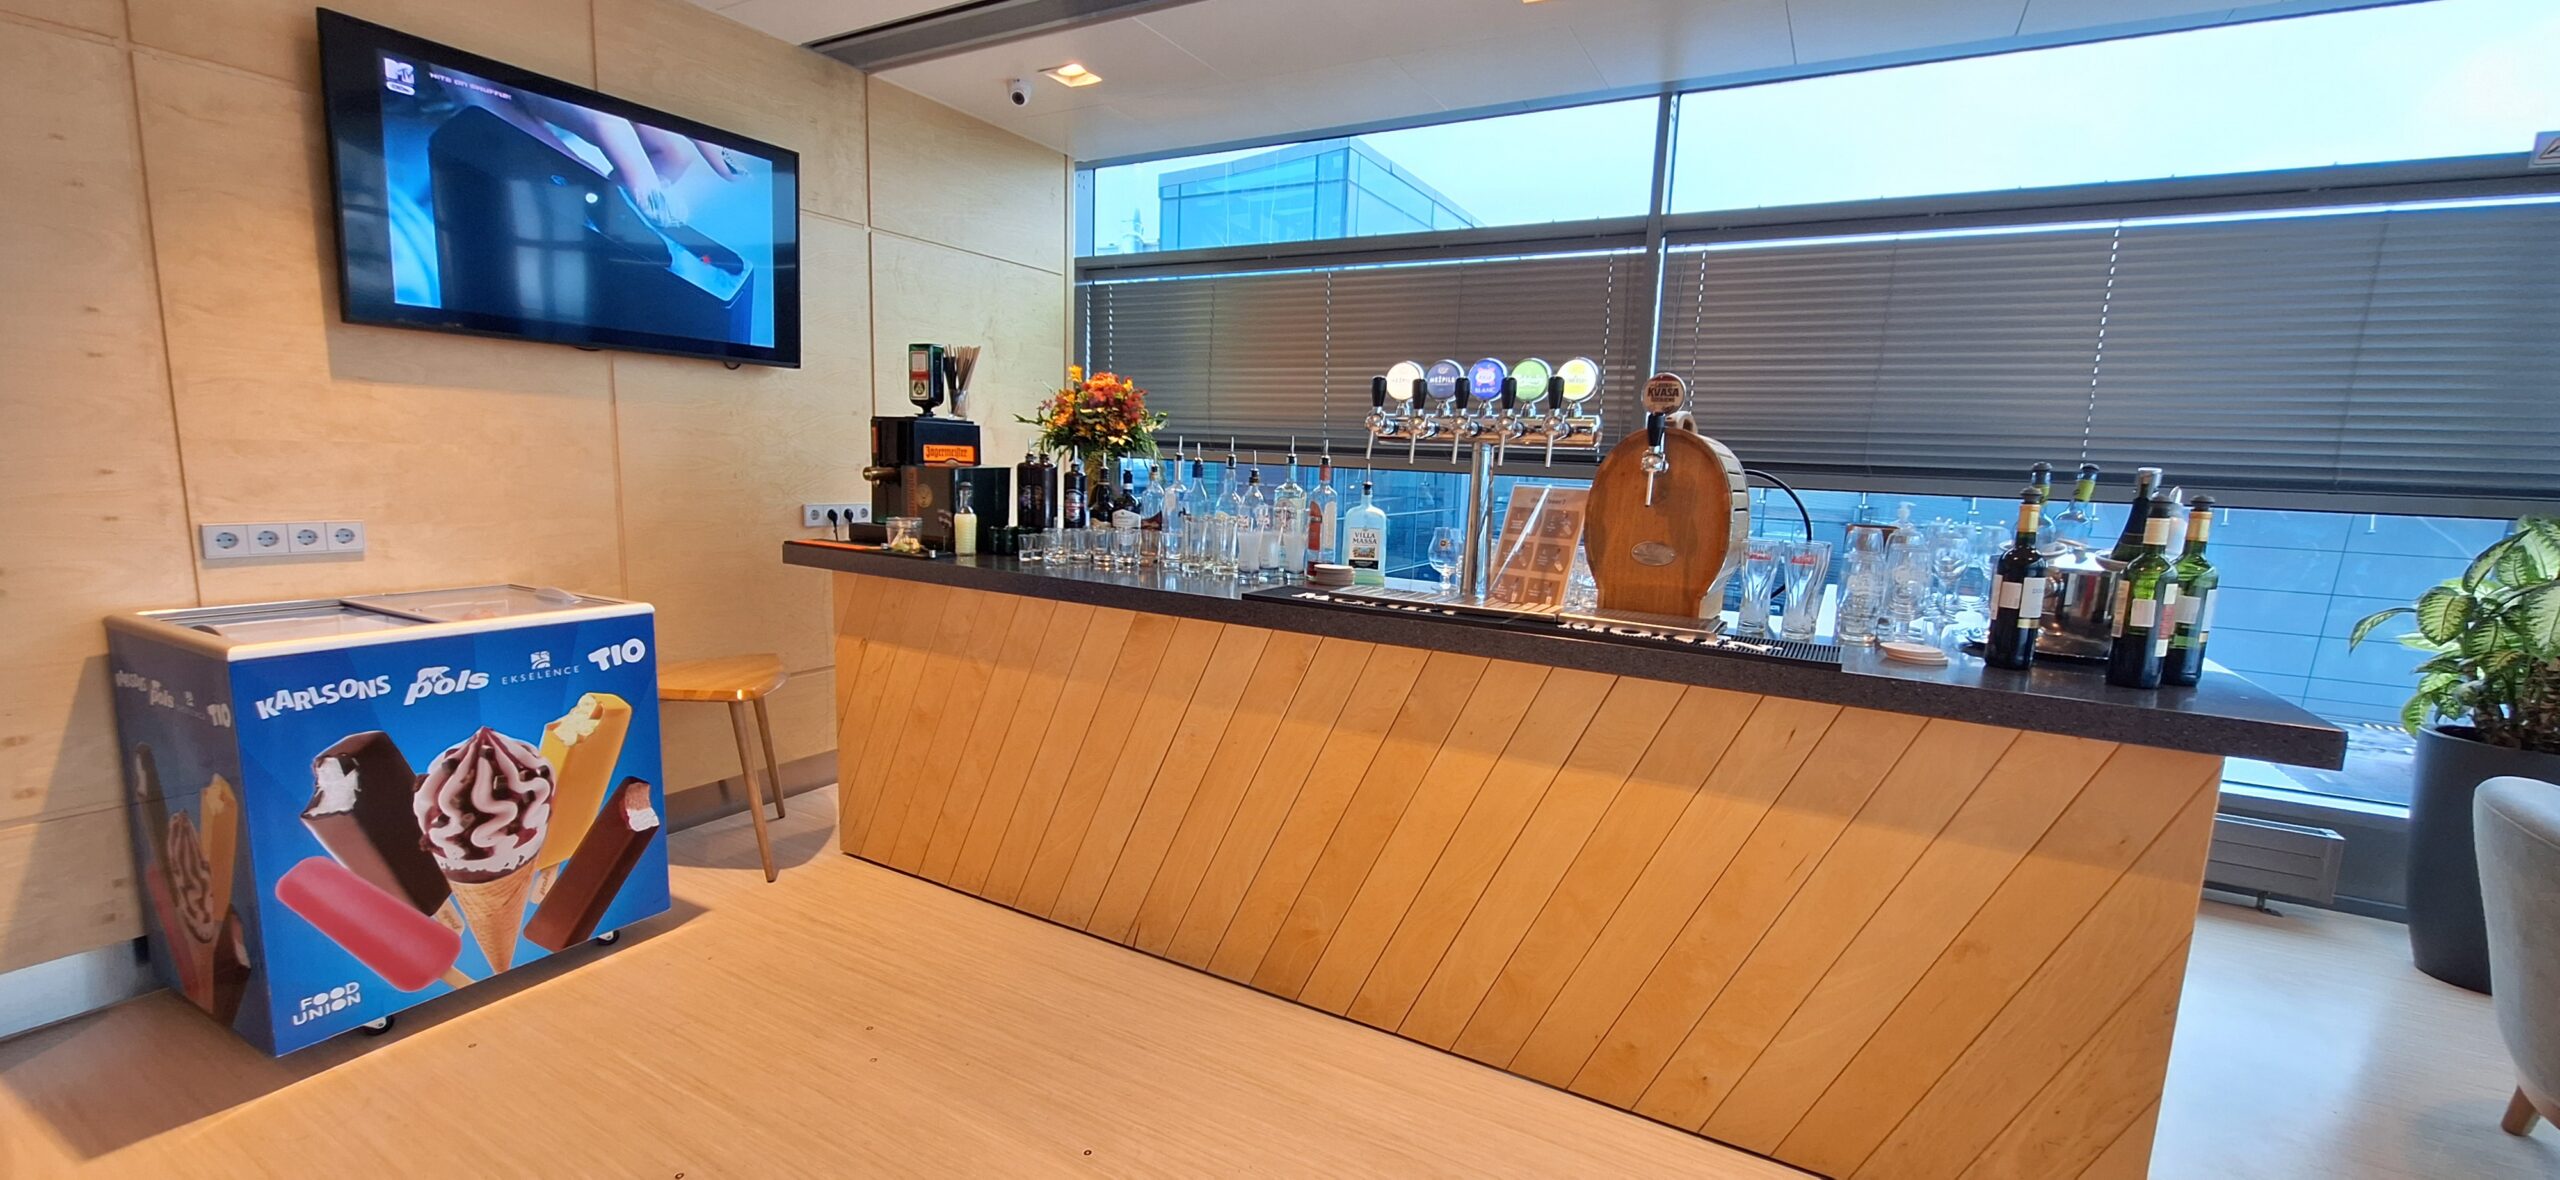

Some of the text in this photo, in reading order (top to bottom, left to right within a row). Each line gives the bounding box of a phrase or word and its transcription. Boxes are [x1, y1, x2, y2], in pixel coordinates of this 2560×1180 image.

[1647, 387, 1680, 397] KVASA
[588, 638, 646, 671] TIO
[501, 664, 581, 685] EKSELENCE
[256, 675, 391, 720] KARLSONS
[292, 992, 361, 1026] UNION
[300, 981, 360, 1011] FOOD
